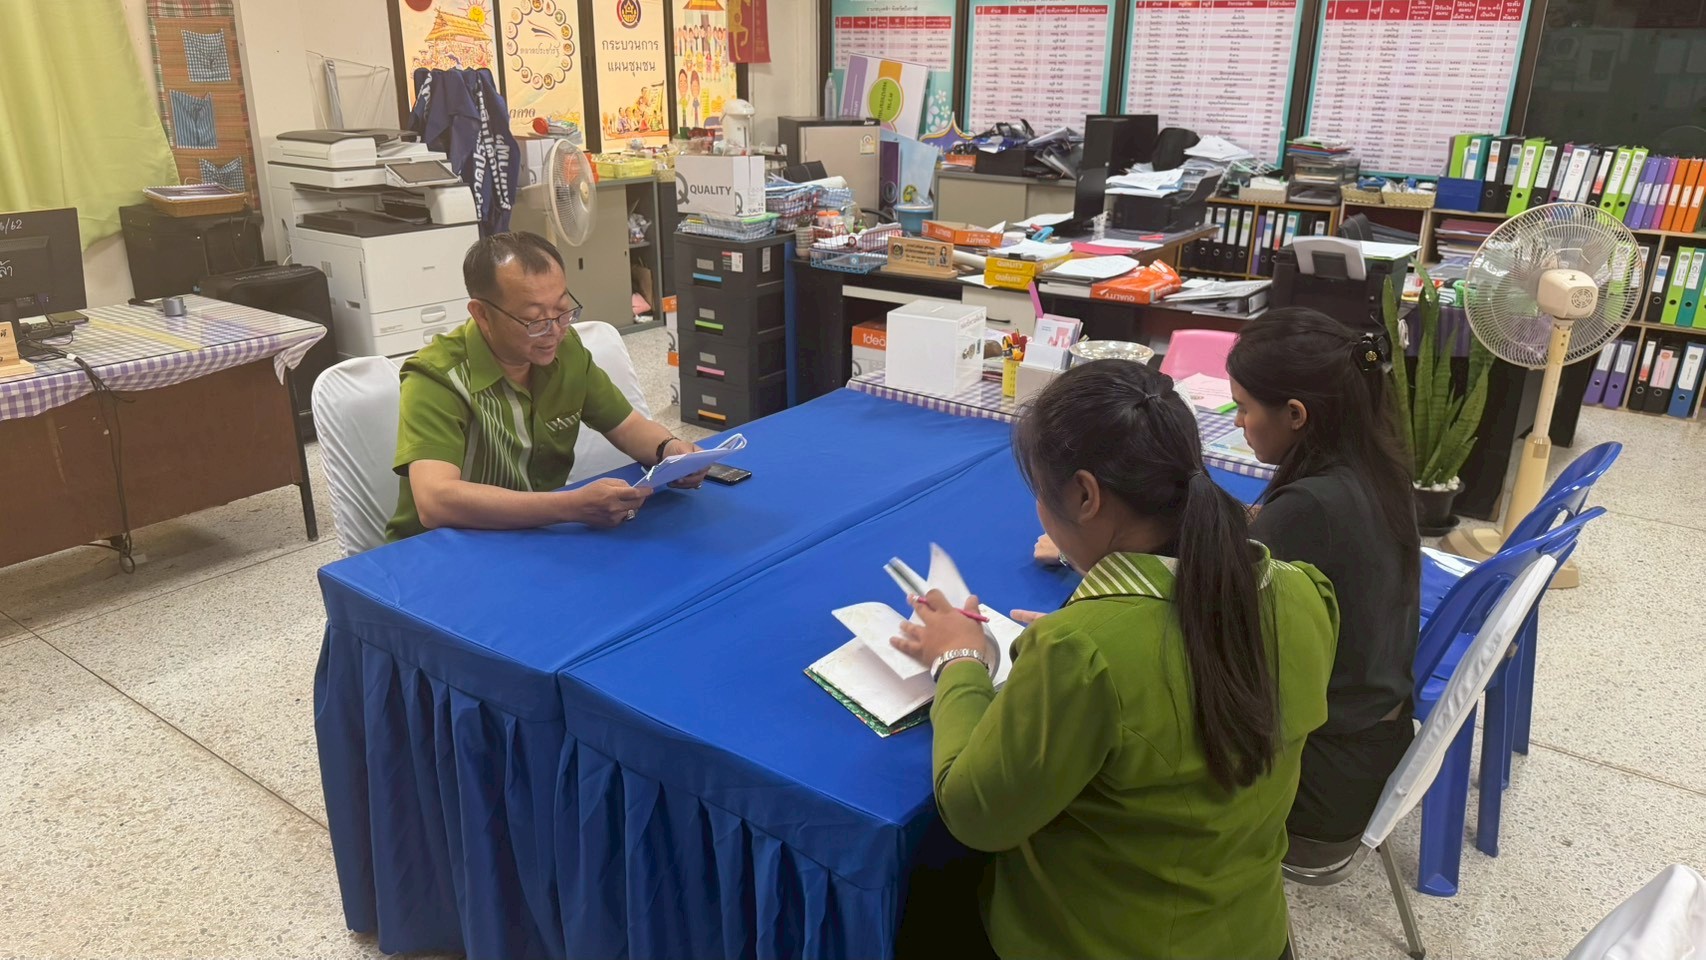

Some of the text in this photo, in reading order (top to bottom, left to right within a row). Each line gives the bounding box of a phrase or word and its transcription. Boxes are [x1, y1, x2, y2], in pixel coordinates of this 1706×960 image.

[602, 39, 659, 51] กระบวนการ
[608, 61, 656, 77] แผนชุมชน
[689, 184, 732, 196] QUALITY
[996, 260, 1024, 269] QUALITY
[994, 273, 1022, 283] QUALITY
[1104, 292, 1135, 302] QUALITY
